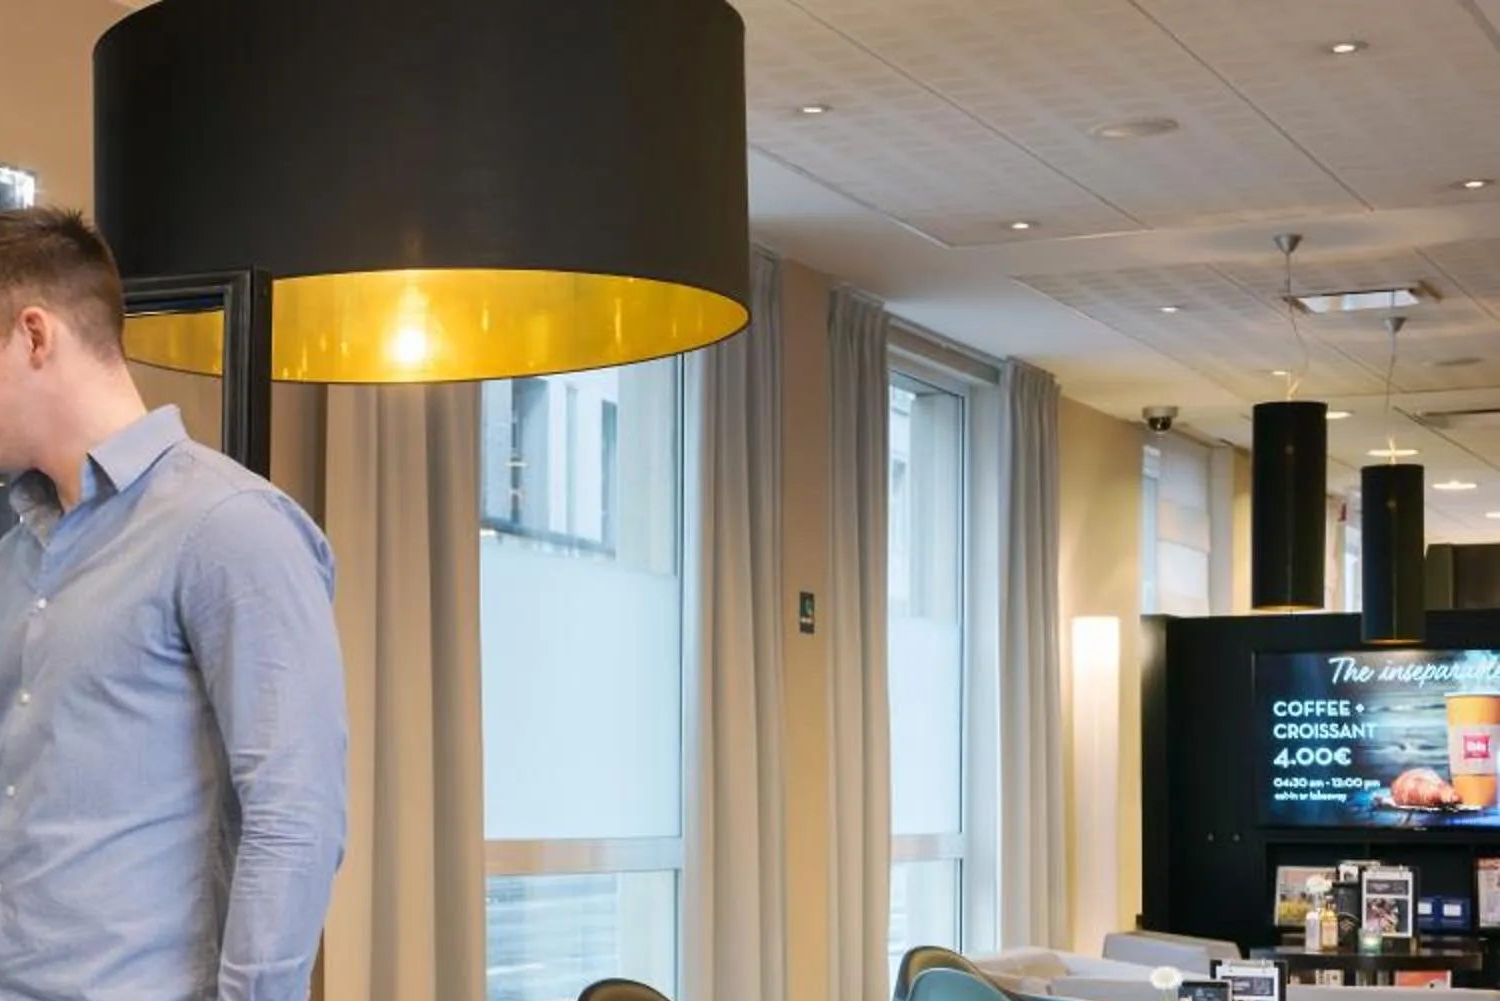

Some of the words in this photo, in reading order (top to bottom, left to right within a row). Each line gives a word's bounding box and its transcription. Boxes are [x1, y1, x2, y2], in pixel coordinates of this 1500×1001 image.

[1328, 657, 1375, 684] The
[1273, 700, 1350, 717] COFFEE
[1273, 723, 1378, 739] CROISSANT
[1273, 747, 1352, 768] 4.00€
